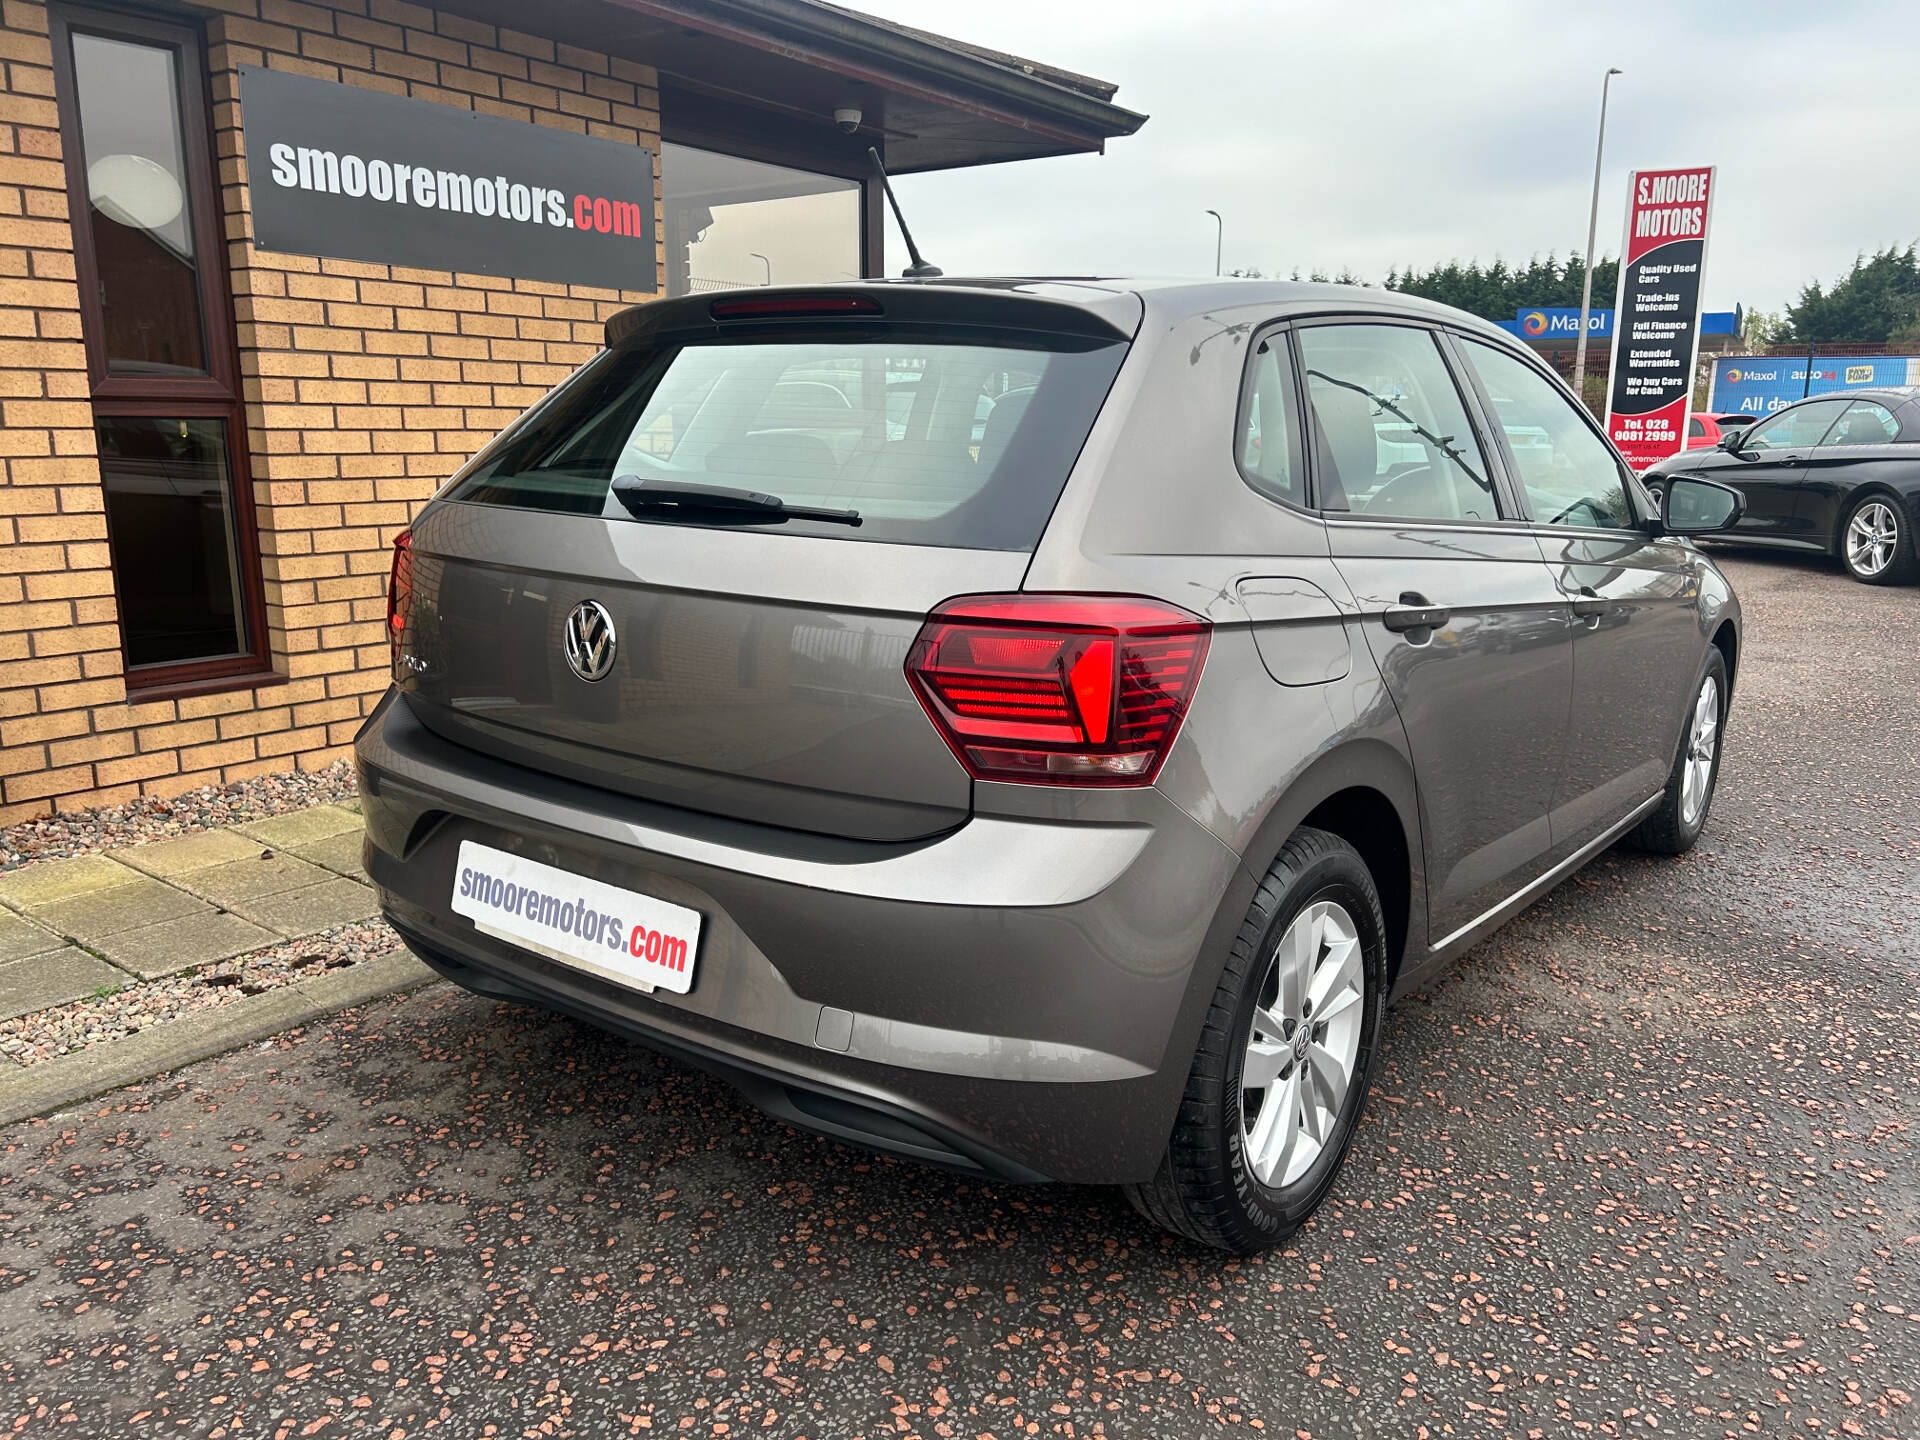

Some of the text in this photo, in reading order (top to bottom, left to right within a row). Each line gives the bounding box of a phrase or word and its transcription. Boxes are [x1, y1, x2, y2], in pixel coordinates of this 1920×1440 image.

[269, 142, 641, 238] smooremotors.com
[1638, 174, 1708, 205] S.MOORE
[1636, 207, 1702, 237] MOTORS
[1639, 263, 1697, 274] Quality Used
[1638, 275, 1660, 284] Cars
[1635, 303, 1679, 312] Welcome
[1550, 313, 1605, 331] Maol
[1633, 321, 1687, 331] Full Finance
[1632, 331, 1675, 340] Welcome
[1630, 349, 1671, 358] Extended
[1629, 359, 1680, 368] Warranties
[1743, 371, 1777, 381] Maxol
[1627, 377, 1683, 387] We buy Cars
[1626, 386, 1664, 395] for Cash
[1740, 397, 1763, 411] All
[1623, 419, 1669, 430] Tel. 028
[1614, 430, 1676, 441] 9081 2999
[460, 867, 688, 973] smooremotors.com
